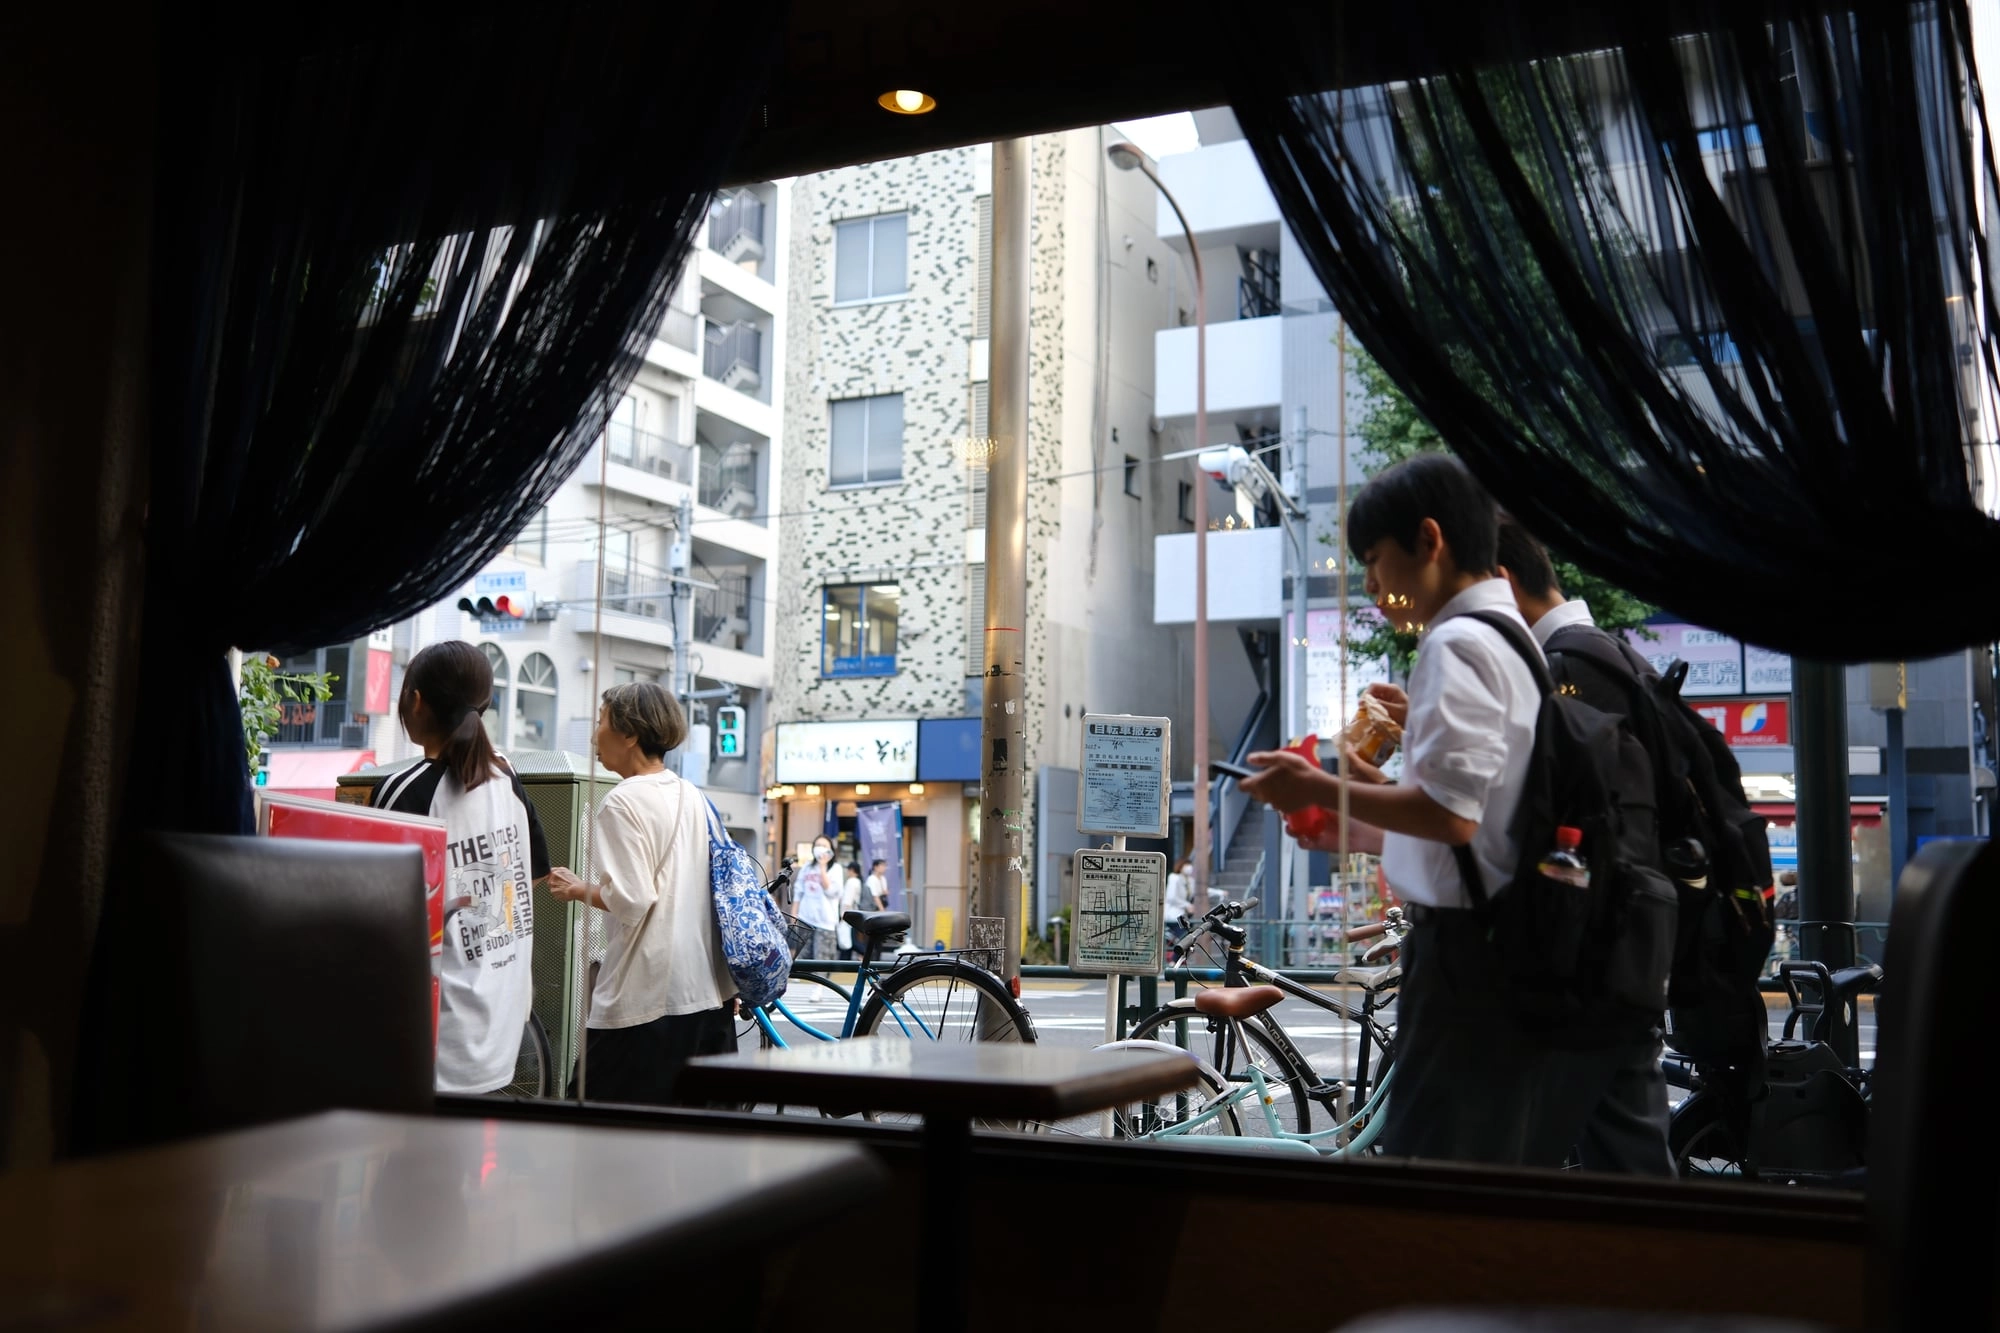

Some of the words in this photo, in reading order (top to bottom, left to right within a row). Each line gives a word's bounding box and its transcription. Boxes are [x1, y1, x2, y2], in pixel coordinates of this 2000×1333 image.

[875, 739, 912, 765] そば
[447, 834, 493, 868] THE
[472, 874, 496, 899] CAT
[514, 861, 533, 937] TOGETHER
[460, 926, 470, 948] &
[465, 945, 484, 962] BE
[1257, 1012, 1302, 1068] HEVROLET
